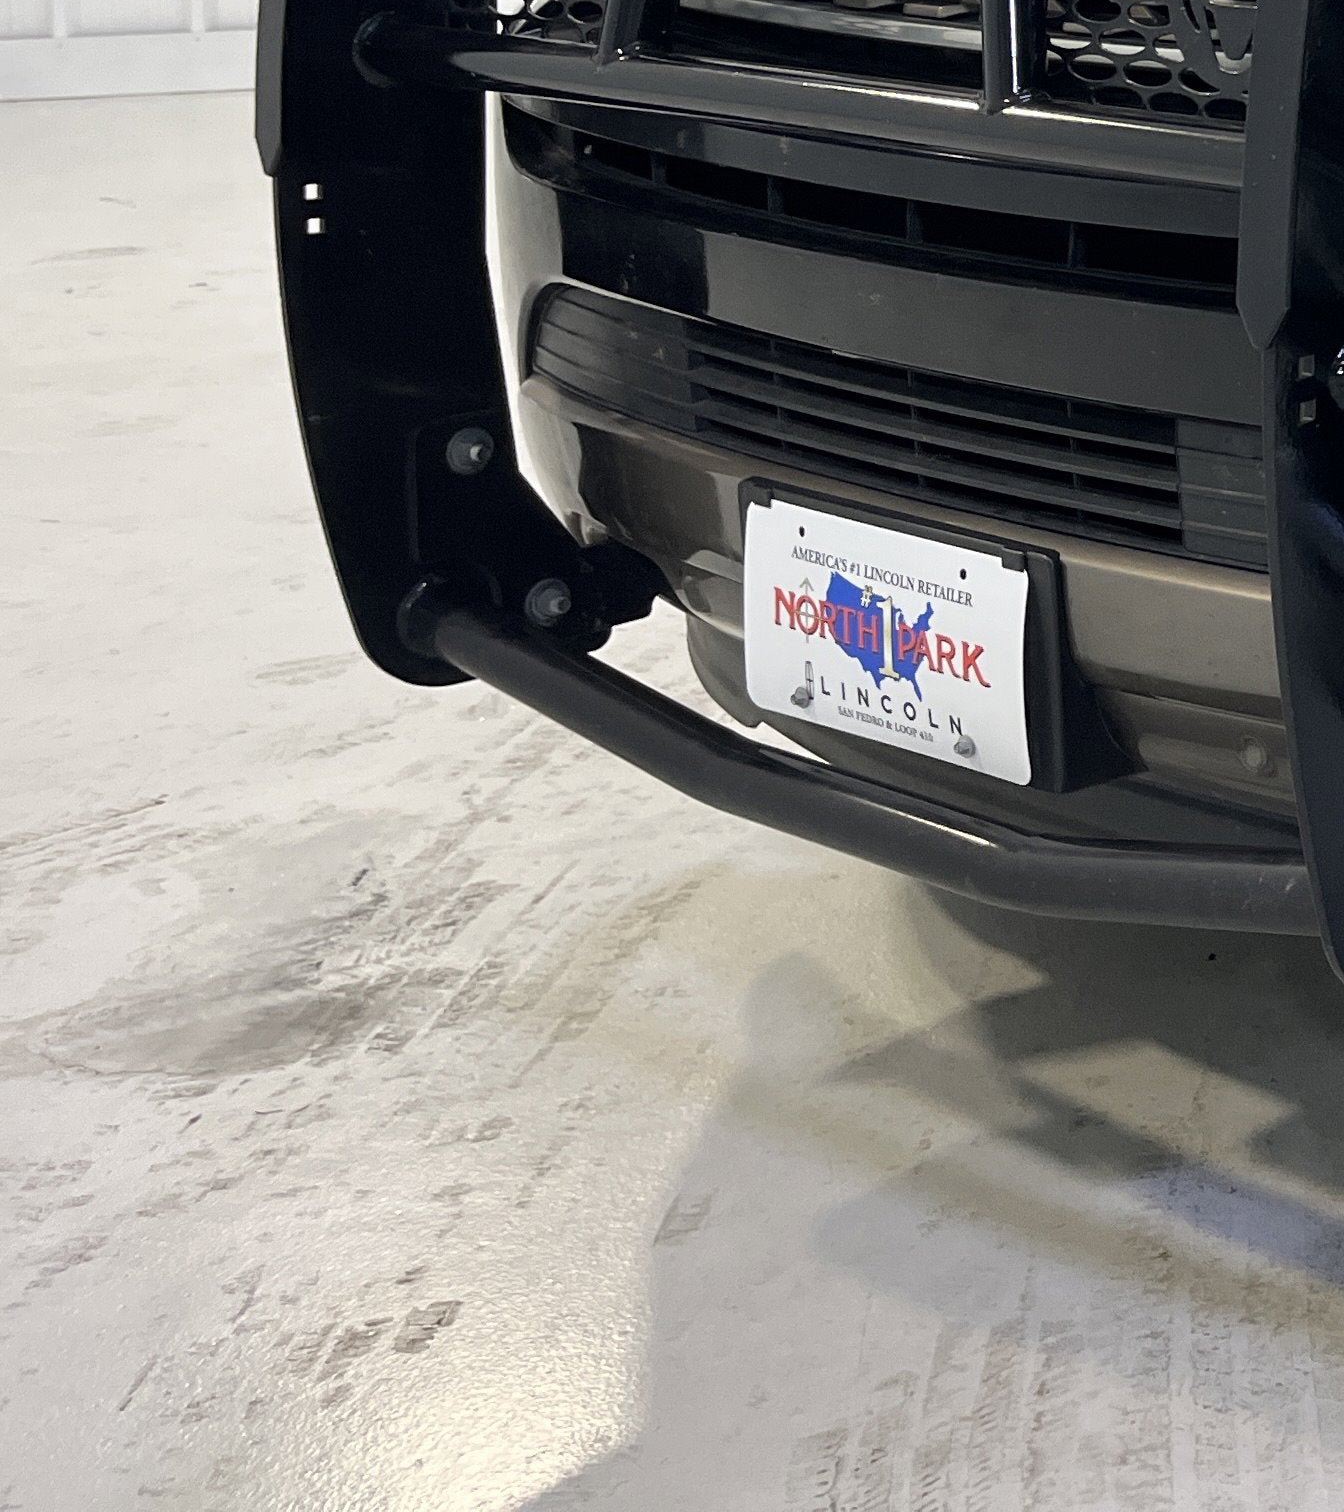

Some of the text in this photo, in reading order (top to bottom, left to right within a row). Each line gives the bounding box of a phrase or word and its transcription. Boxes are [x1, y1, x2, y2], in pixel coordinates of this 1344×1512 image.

[791, 545, 974, 608] AMERICA'S #1 LINCOLN RETAILER
[774, 586, 992, 688] NORTH PARK
[821, 675, 963, 737] LINCOLN
